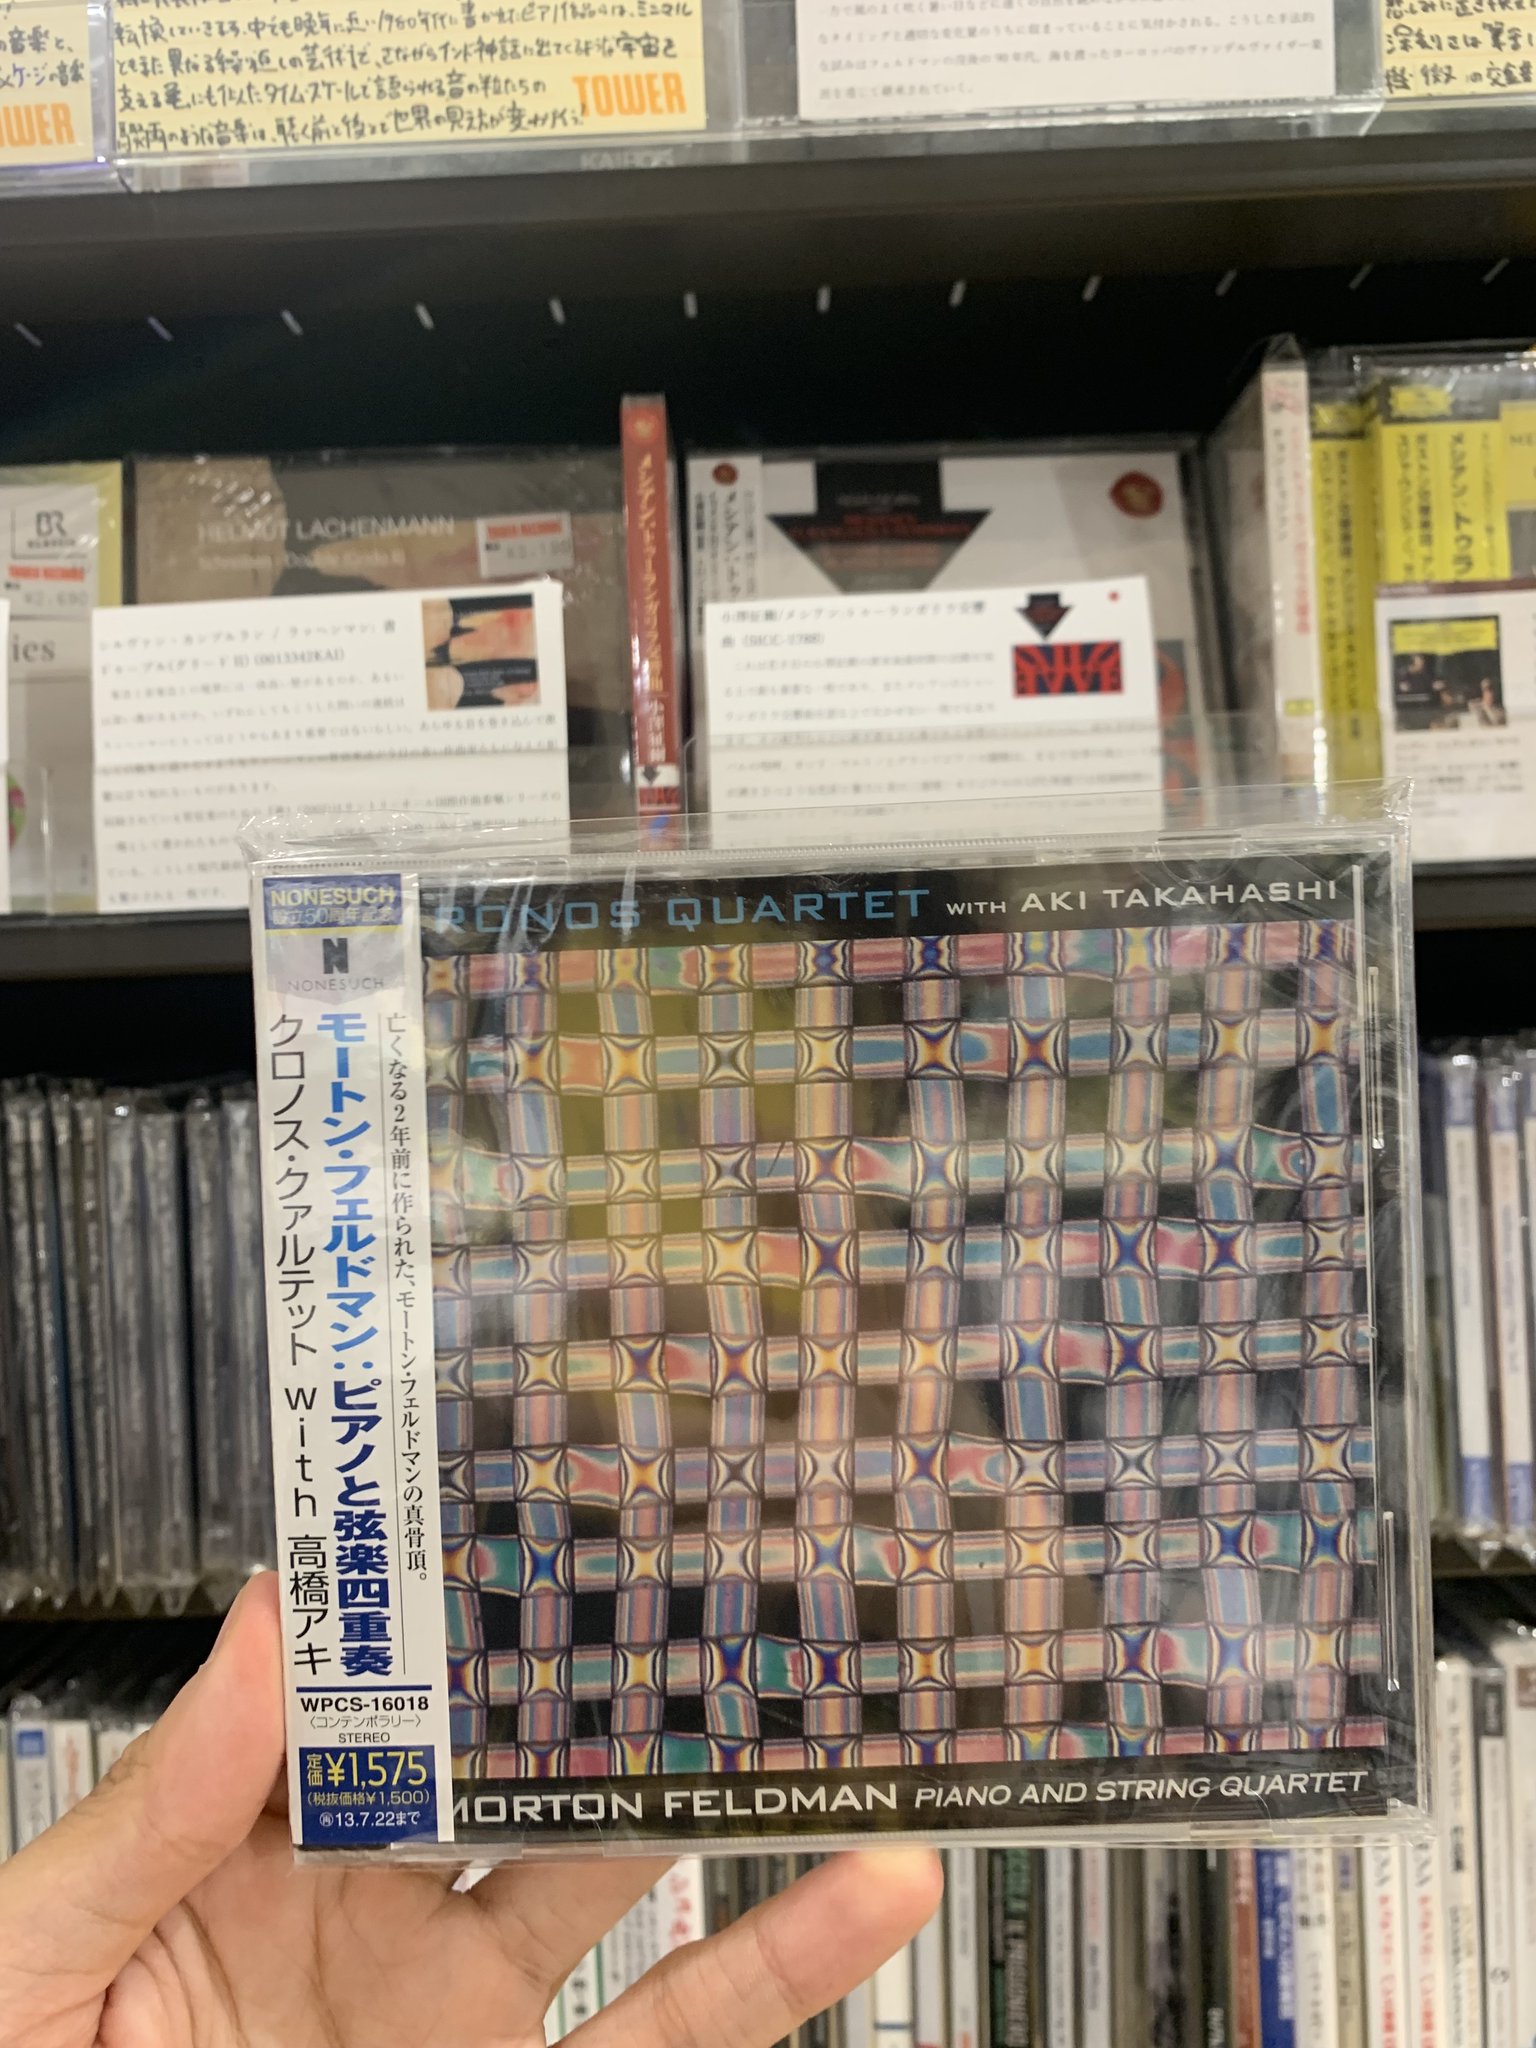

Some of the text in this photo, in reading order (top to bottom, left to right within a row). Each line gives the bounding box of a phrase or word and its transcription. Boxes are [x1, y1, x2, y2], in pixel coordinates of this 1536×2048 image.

[572, 72, 687, 118] TOWER
[0, 102, 75, 147] WER
[295, 514, 455, 541] LACHENMANN
[270, 887, 395, 907] NONESUCH
[272, 906, 395, 926] 設立50周年記念
[434, 880, 1337, 934] RONOS QUARTET WITH AKI TAKAHASHI
[322, 938, 349, 975] N
[288, 977, 384, 992] NONESUCH
[269, 1014, 318, 1367] クロノス・クァルテット
[385, 1012, 428, 1581] 亡くなる2年前に作られた、モートン・フェルドマンの真骨頂。
[317, 1013, 393, 1677] モートン・フェルドマン：ピアノと弦楽四重奏
[287, 1534, 332, 1676] 高橋アキ
[300, 1696, 429, 1713] WPCS-16018
[338, 1733, 390, 1744] STEREO
[324, 1751, 428, 1790] ¥1,575
[307, 1788, 430, 1807] (税抜価格¥1,500)
[664, 1783, 897, 1818] FELDMAN
[914, 1784, 1011, 1809] PIANO
[1019, 1780, 1088, 1804] AND
[1096, 1776, 1211, 1802] STRING
[1219, 1771, 1368, 1797] QUARTET
